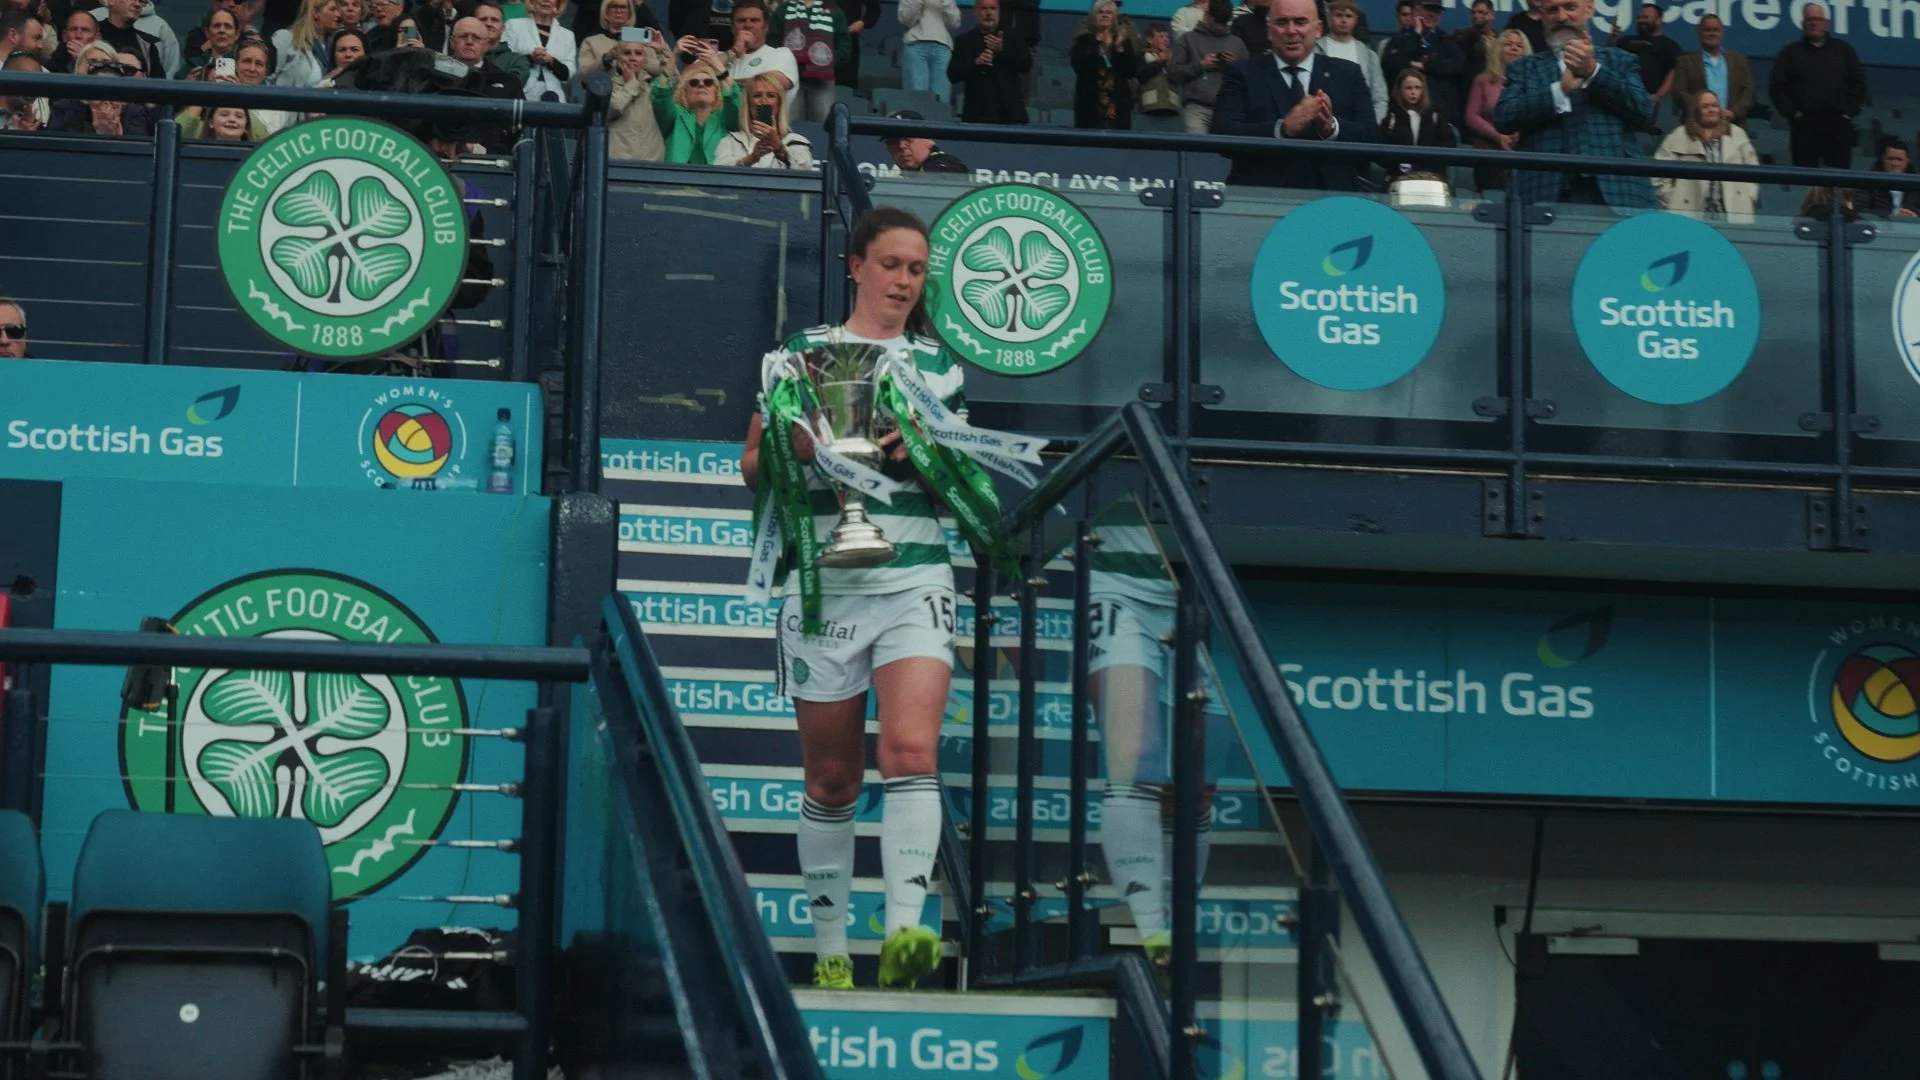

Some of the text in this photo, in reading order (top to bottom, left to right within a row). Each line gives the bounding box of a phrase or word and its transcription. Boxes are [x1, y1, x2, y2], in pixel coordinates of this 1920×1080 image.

[1861, 0, 1920, 39] th
[228, 127, 456, 245] THE CELTIC FOOTBALL CLUB
[941, 197, 993, 242] CELTIC
[995, 192, 1083, 240] FOOTBALL
[1077, 237, 1105, 285] CLUB
[1279, 281, 1418, 314] Scottish
[1599, 297, 1735, 328] Scottish
[311, 324, 364, 347] 1888
[1318, 315, 1381, 345] Gas
[1637, 330, 1700, 360] Gas
[995, 349, 1036, 367] 1888
[374, 386, 453, 409] WOMEN'S
[8, 419, 223, 457] Scottish Gas
[601, 450, 690, 473] ottish
[619, 518, 703, 543] ottish
[711, 521, 753, 547] Ga
[631, 597, 717, 625] ottish
[924, 596, 954, 634] 15
[1828, 616, 1920, 646] WOMEN
[668, 681, 734, 710] tish
[1279, 664, 1594, 718] Scottish Gas
[1813, 731, 1919, 791] SCOTTISH
[808, 1026, 999, 1072] tish Gas
